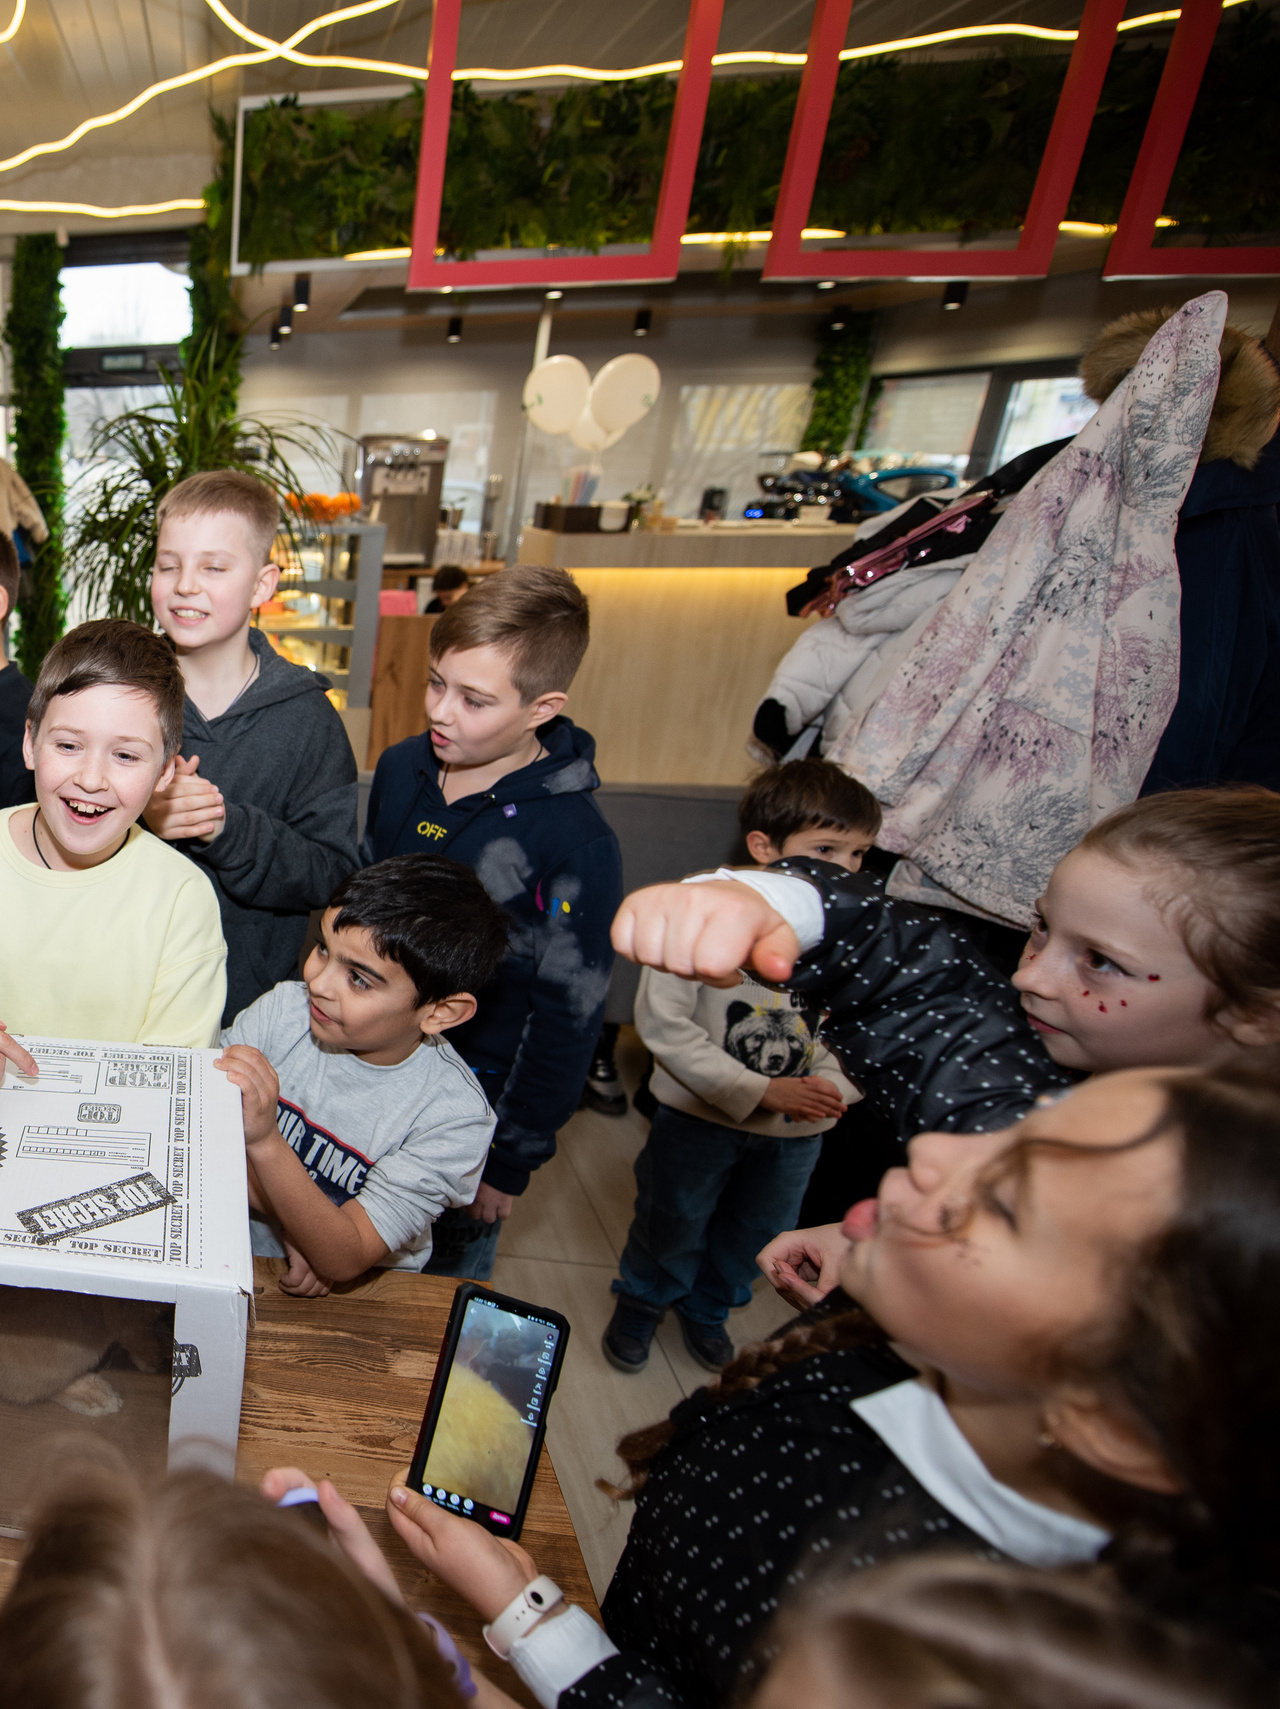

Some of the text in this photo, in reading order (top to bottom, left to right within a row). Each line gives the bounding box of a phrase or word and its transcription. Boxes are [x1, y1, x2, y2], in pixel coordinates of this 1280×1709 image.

[417, 821, 448, 841] OFF
[30, 1047, 95, 1058] TOP SECRET
[102, 1052, 145, 1060] SECRET
[176, 1055, 187, 1095] TOP SECRET
[81, 1110, 117, 1121] TOP
[174, 1097, 186, 1143] TOP SECRET
[172, 1147, 184, 1197] TOP SECRET
[304, 1133, 367, 1195] TIME
[31, 1180, 162, 1234] TOP SECRET
[69, 1240, 162, 1259] TOP SECRET
[170, 1203, 183, 1262] TOP SECRET
